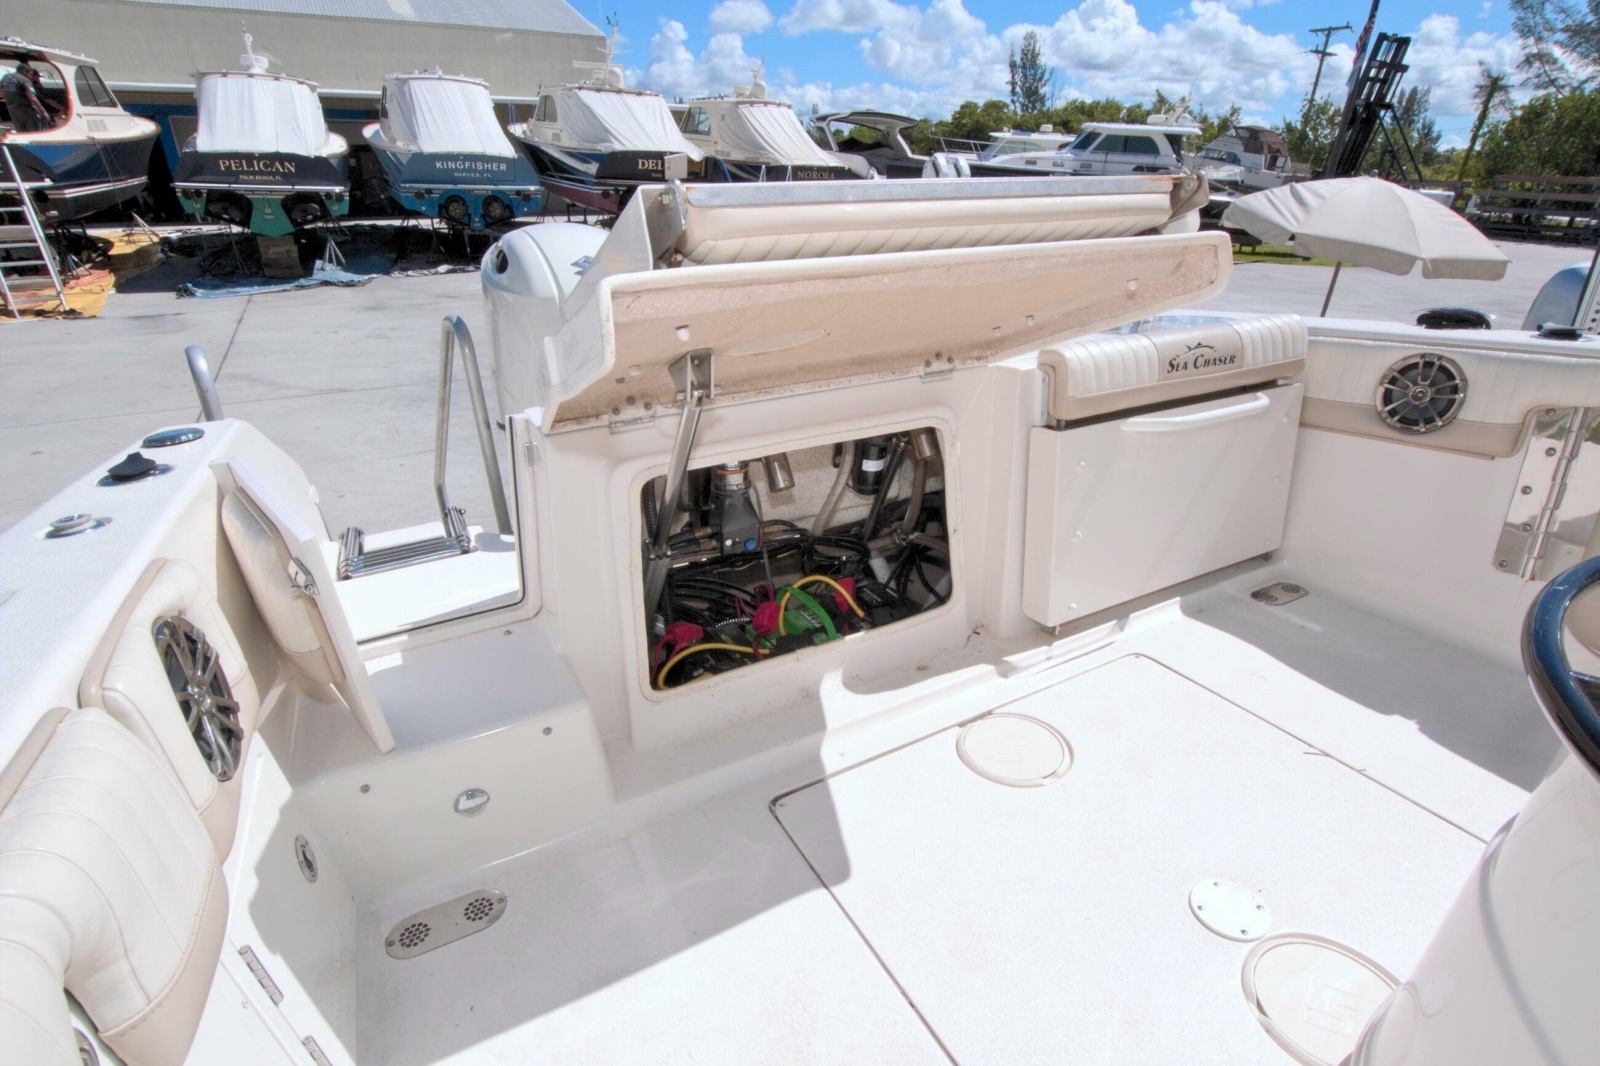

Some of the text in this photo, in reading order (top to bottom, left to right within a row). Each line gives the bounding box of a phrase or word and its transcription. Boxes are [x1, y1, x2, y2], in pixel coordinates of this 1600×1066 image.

[218, 159, 296, 173] PELICAN
[435, 161, 507, 171] KINGFISHER
[1193, 354, 1236, 369] CHASER
